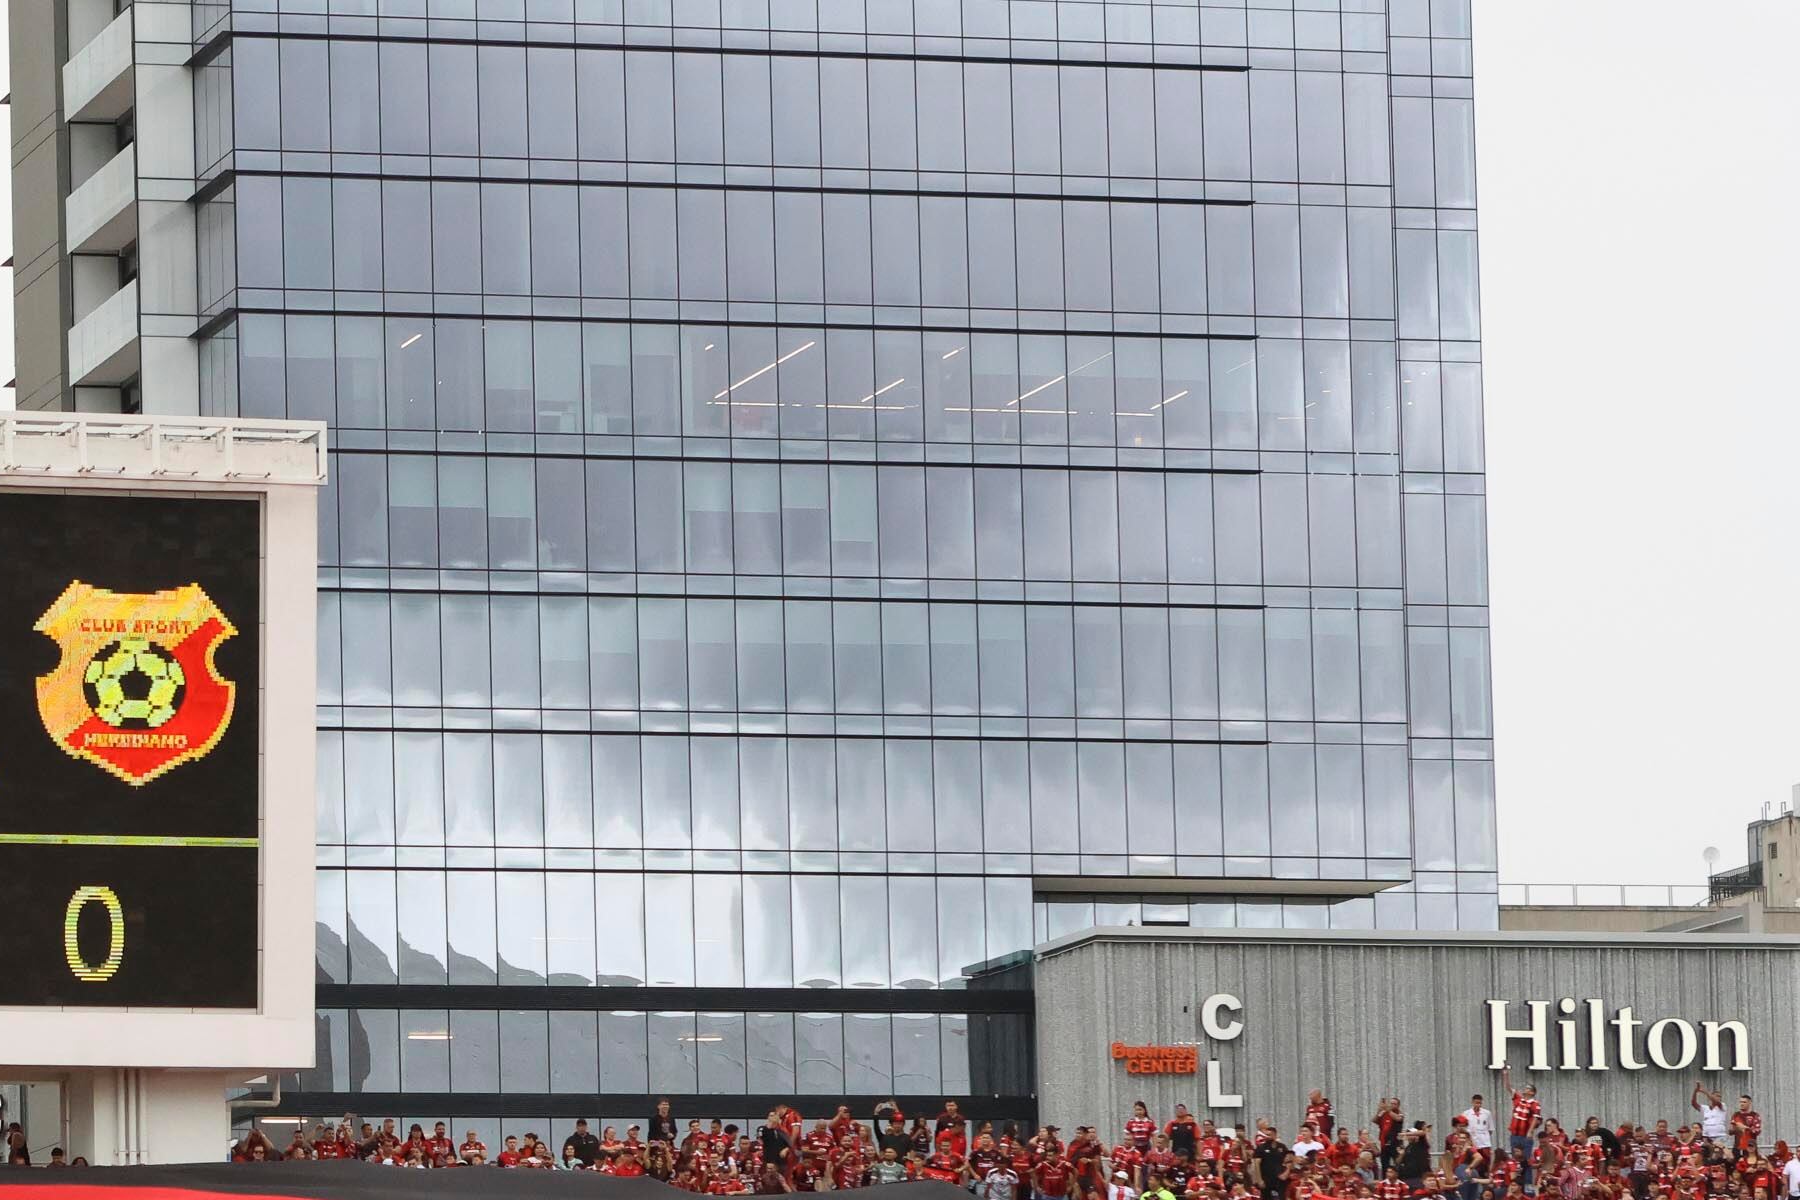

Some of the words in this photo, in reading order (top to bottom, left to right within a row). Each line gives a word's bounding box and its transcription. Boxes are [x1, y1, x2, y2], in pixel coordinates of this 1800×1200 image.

[81, 618, 128, 633] CLUB
[133, 619, 191, 634] SPORT
[64, 886, 126, 982] 0
[1484, 997, 1752, 1070] Hilton
[1111, 1041, 1198, 1059] Business
[1127, 1059, 1198, 1074] CENTER
